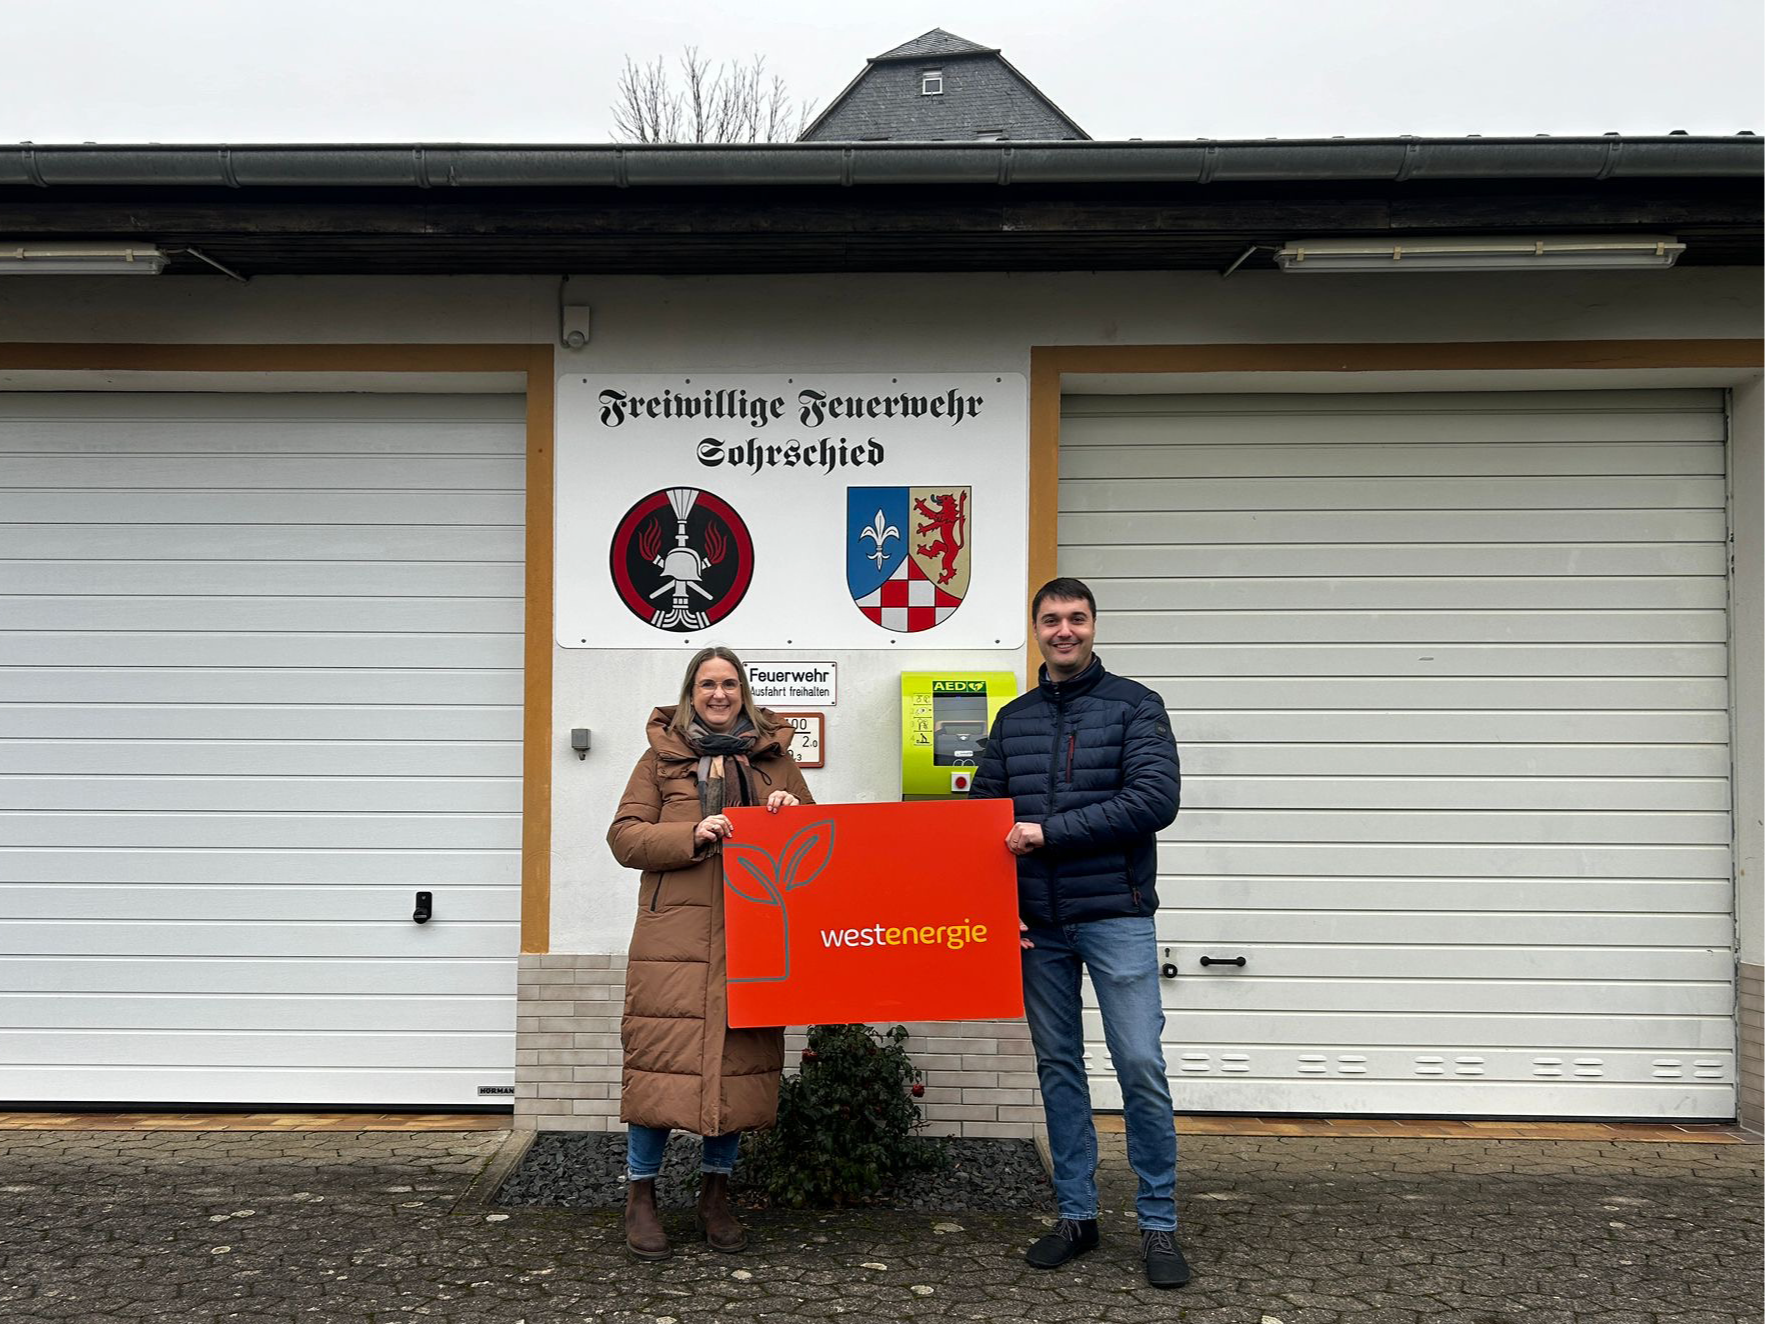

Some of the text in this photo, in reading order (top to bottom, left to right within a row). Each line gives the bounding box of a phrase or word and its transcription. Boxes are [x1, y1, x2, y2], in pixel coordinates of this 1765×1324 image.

[598, 388, 984, 428] Freiwillige Feuerwehr
[696, 437, 885, 475] Sohrschied
[749, 667, 830, 682] Feuerwehr
[933, 681, 967, 691] AED
[750, 686, 830, 697] Ausfahrt freihalten
[820, 918, 988, 950] westenergie
